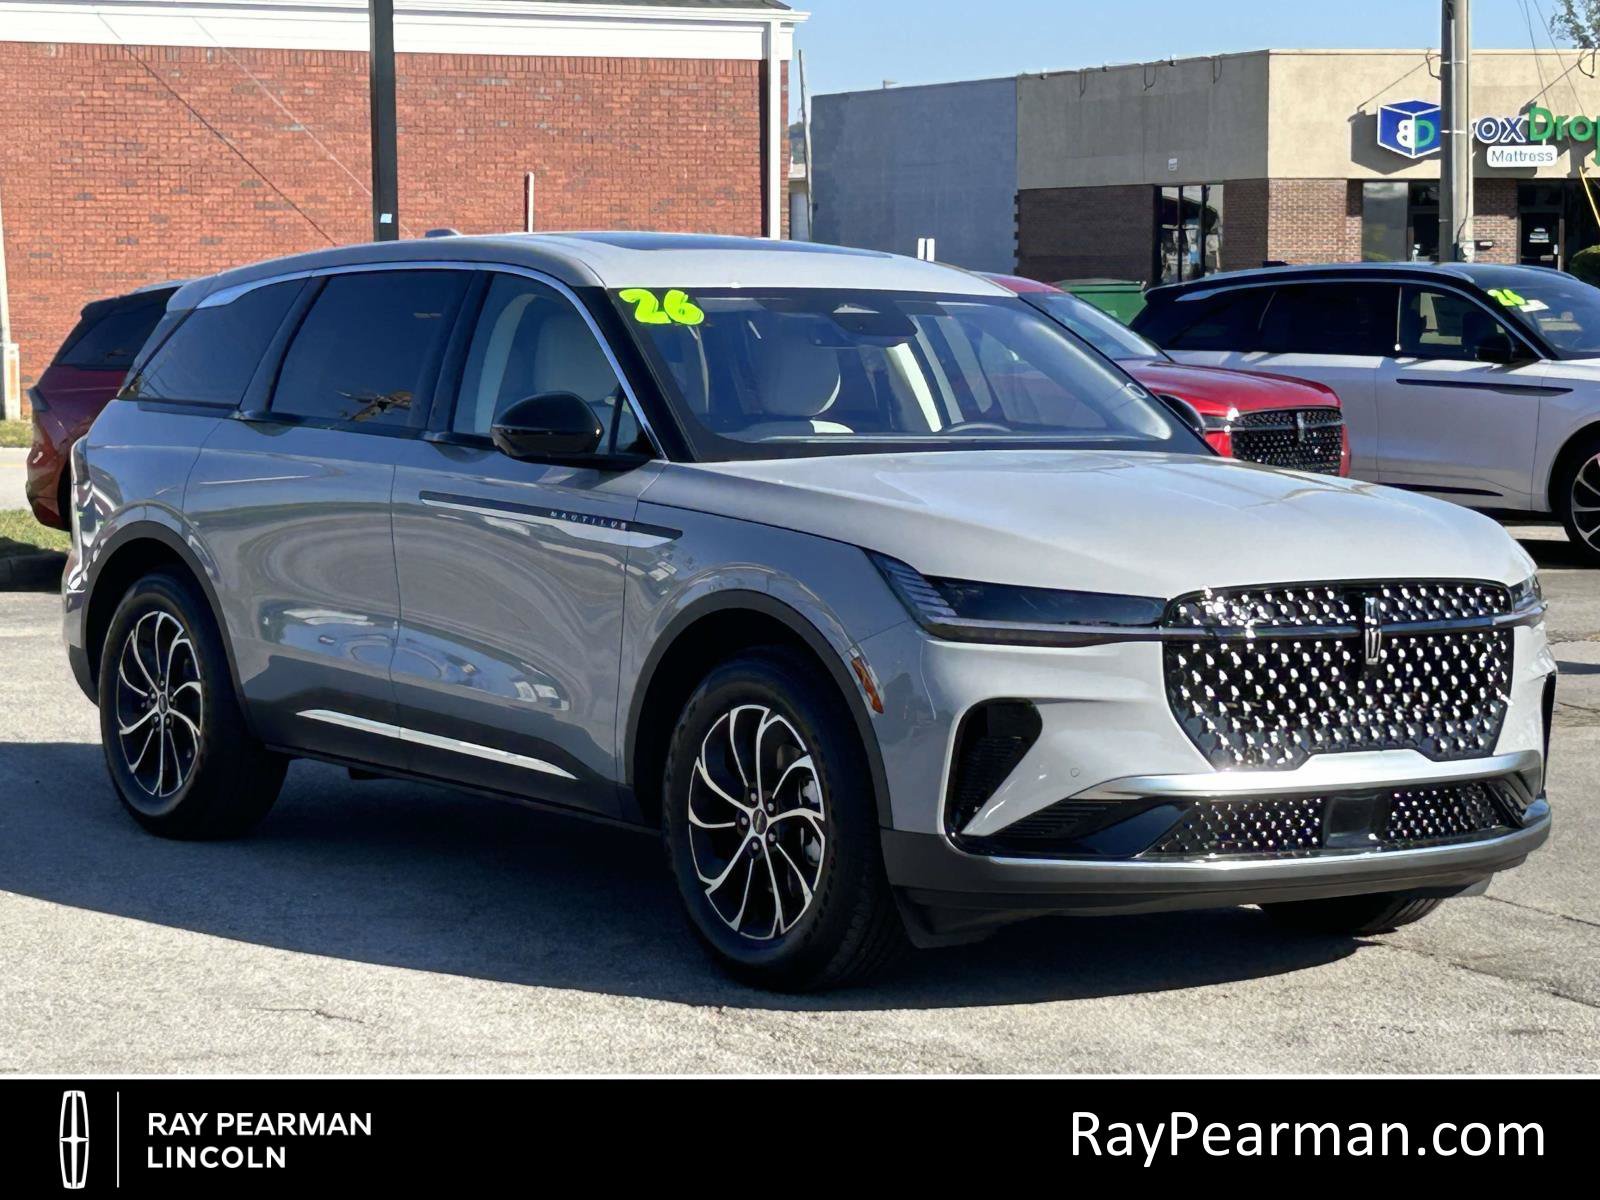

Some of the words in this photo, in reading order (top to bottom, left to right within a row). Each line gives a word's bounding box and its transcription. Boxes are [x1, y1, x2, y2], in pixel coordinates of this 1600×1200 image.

[1474, 105, 1600, 167] oxDro
[619, 288, 705, 325] 26
[550, 511, 627, 530] NAUTILUS
